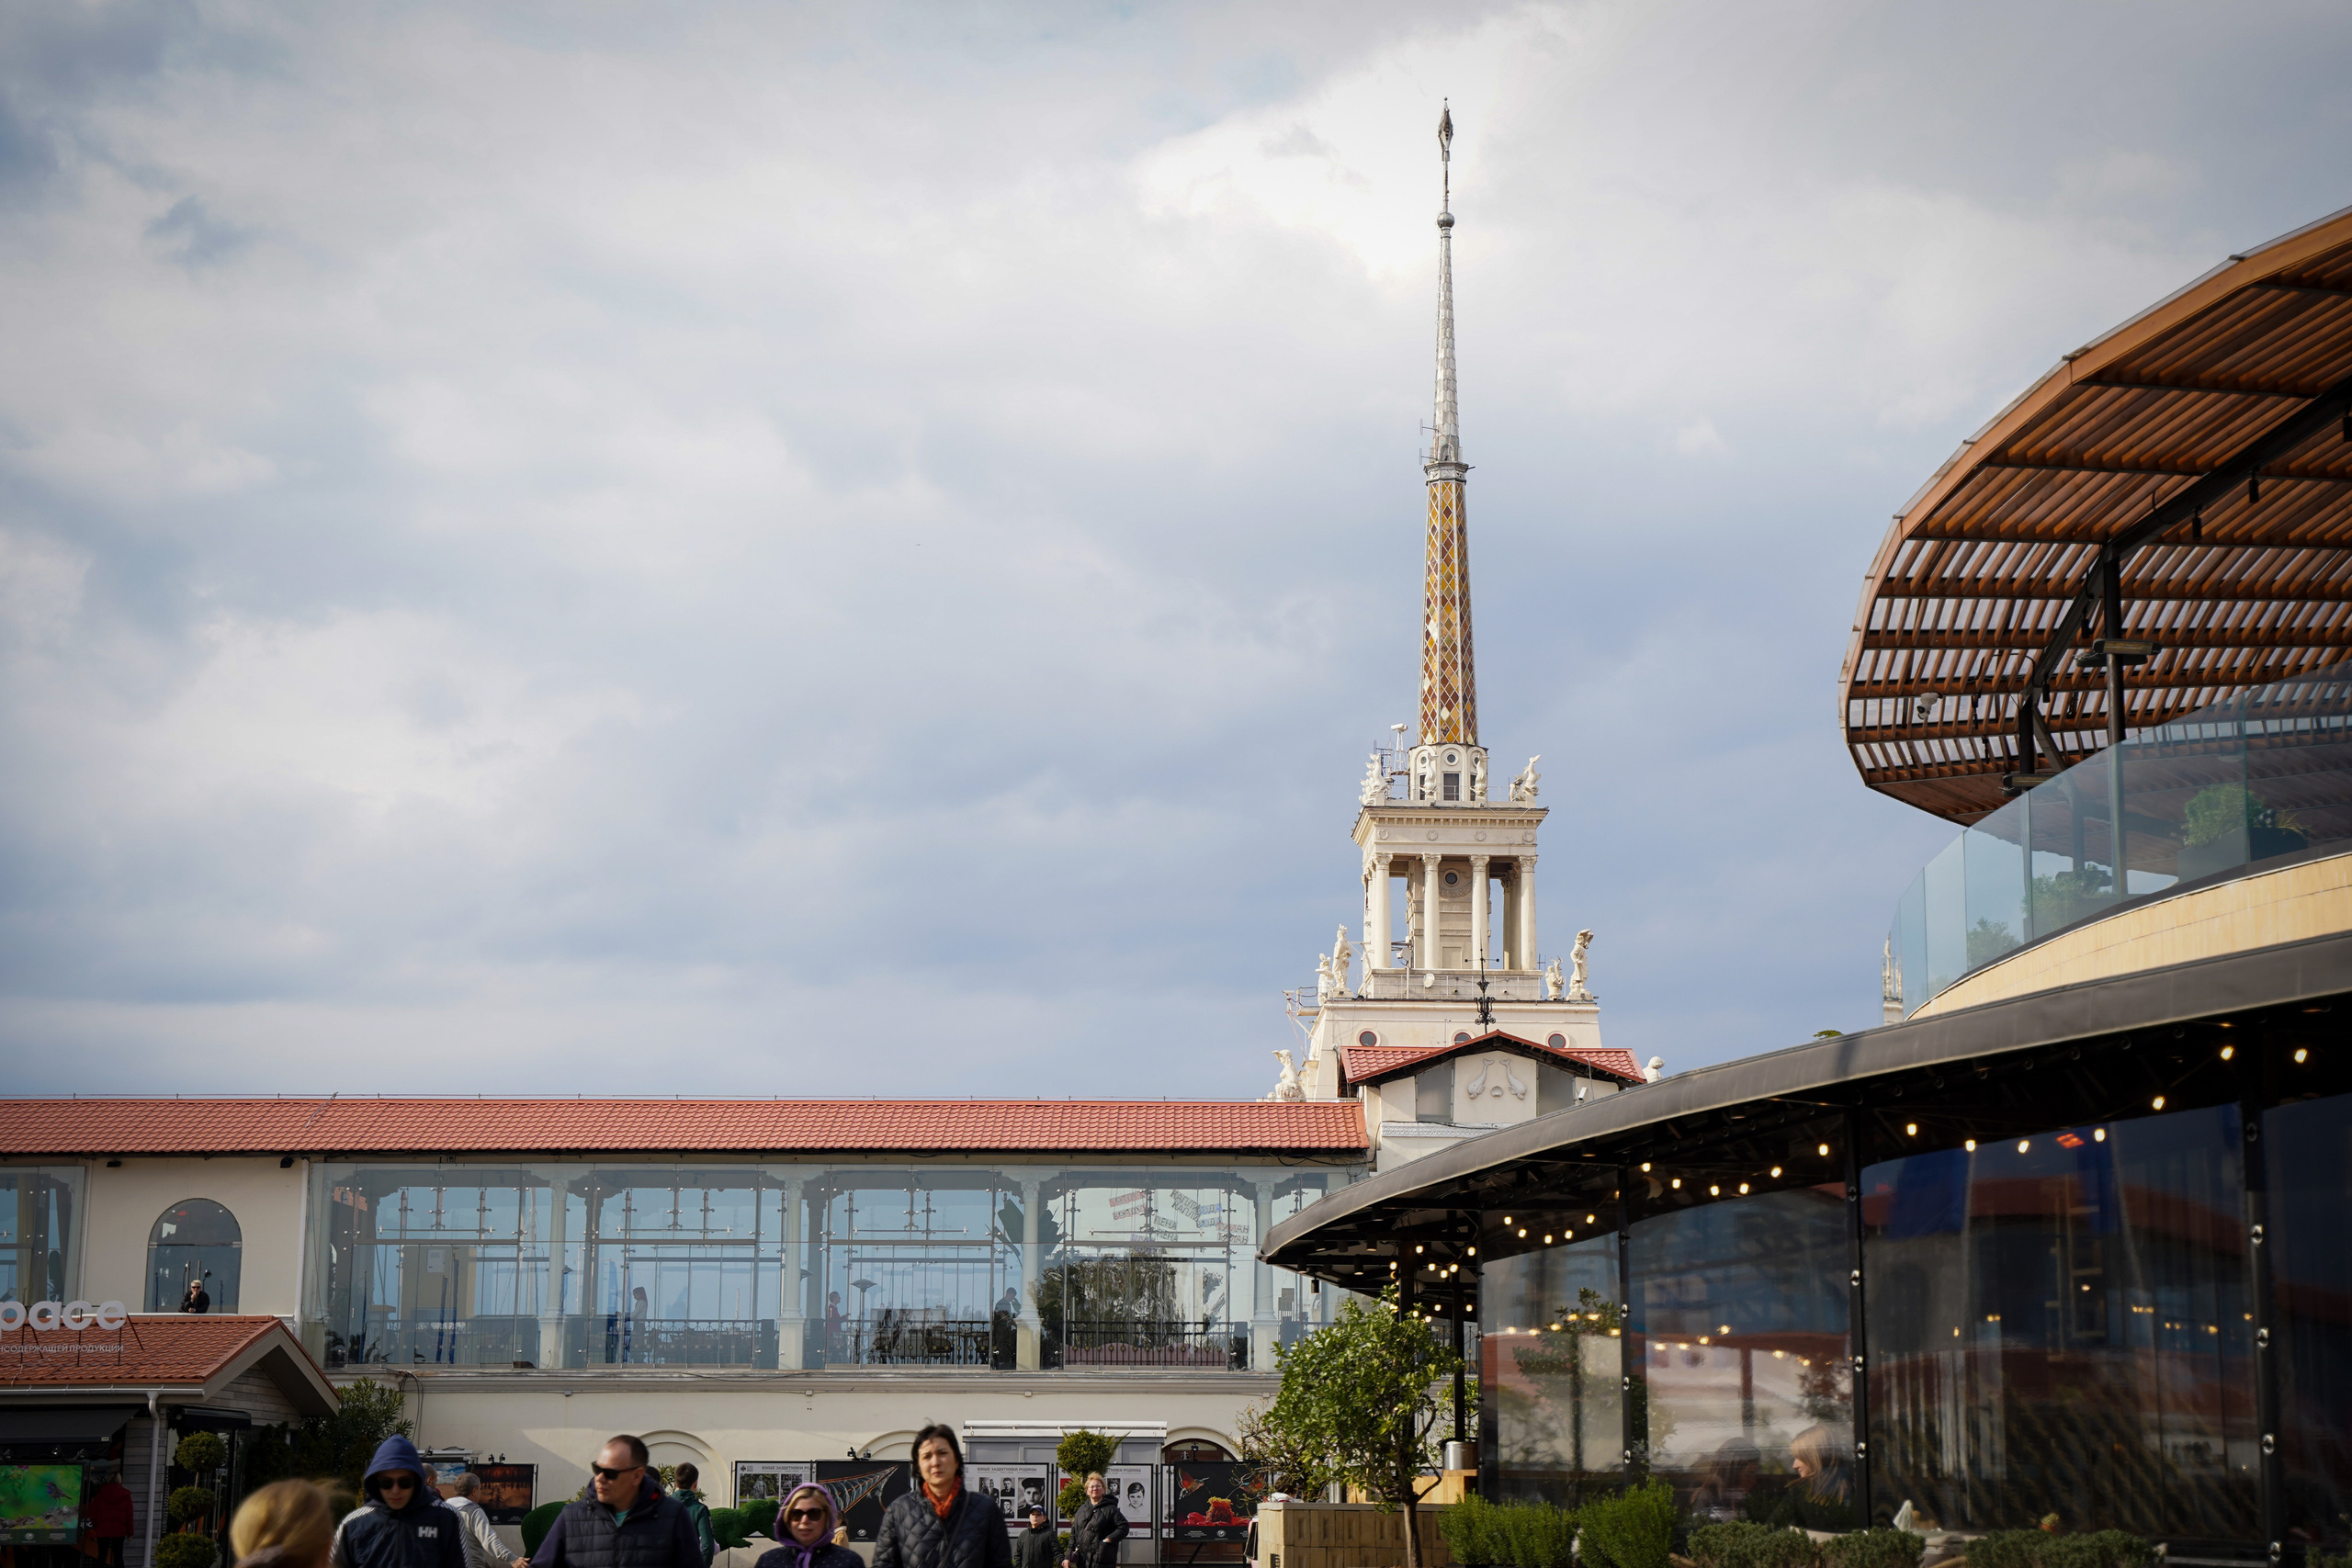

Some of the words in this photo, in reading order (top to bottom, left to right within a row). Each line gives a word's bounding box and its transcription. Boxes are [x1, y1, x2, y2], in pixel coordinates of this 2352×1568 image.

[1154, 1216, 1178, 1230] ПЕНА
[69, 1344, 124, 1353] ПРОДУКЦИИ
[418, 1527, 438, 1538] HH
